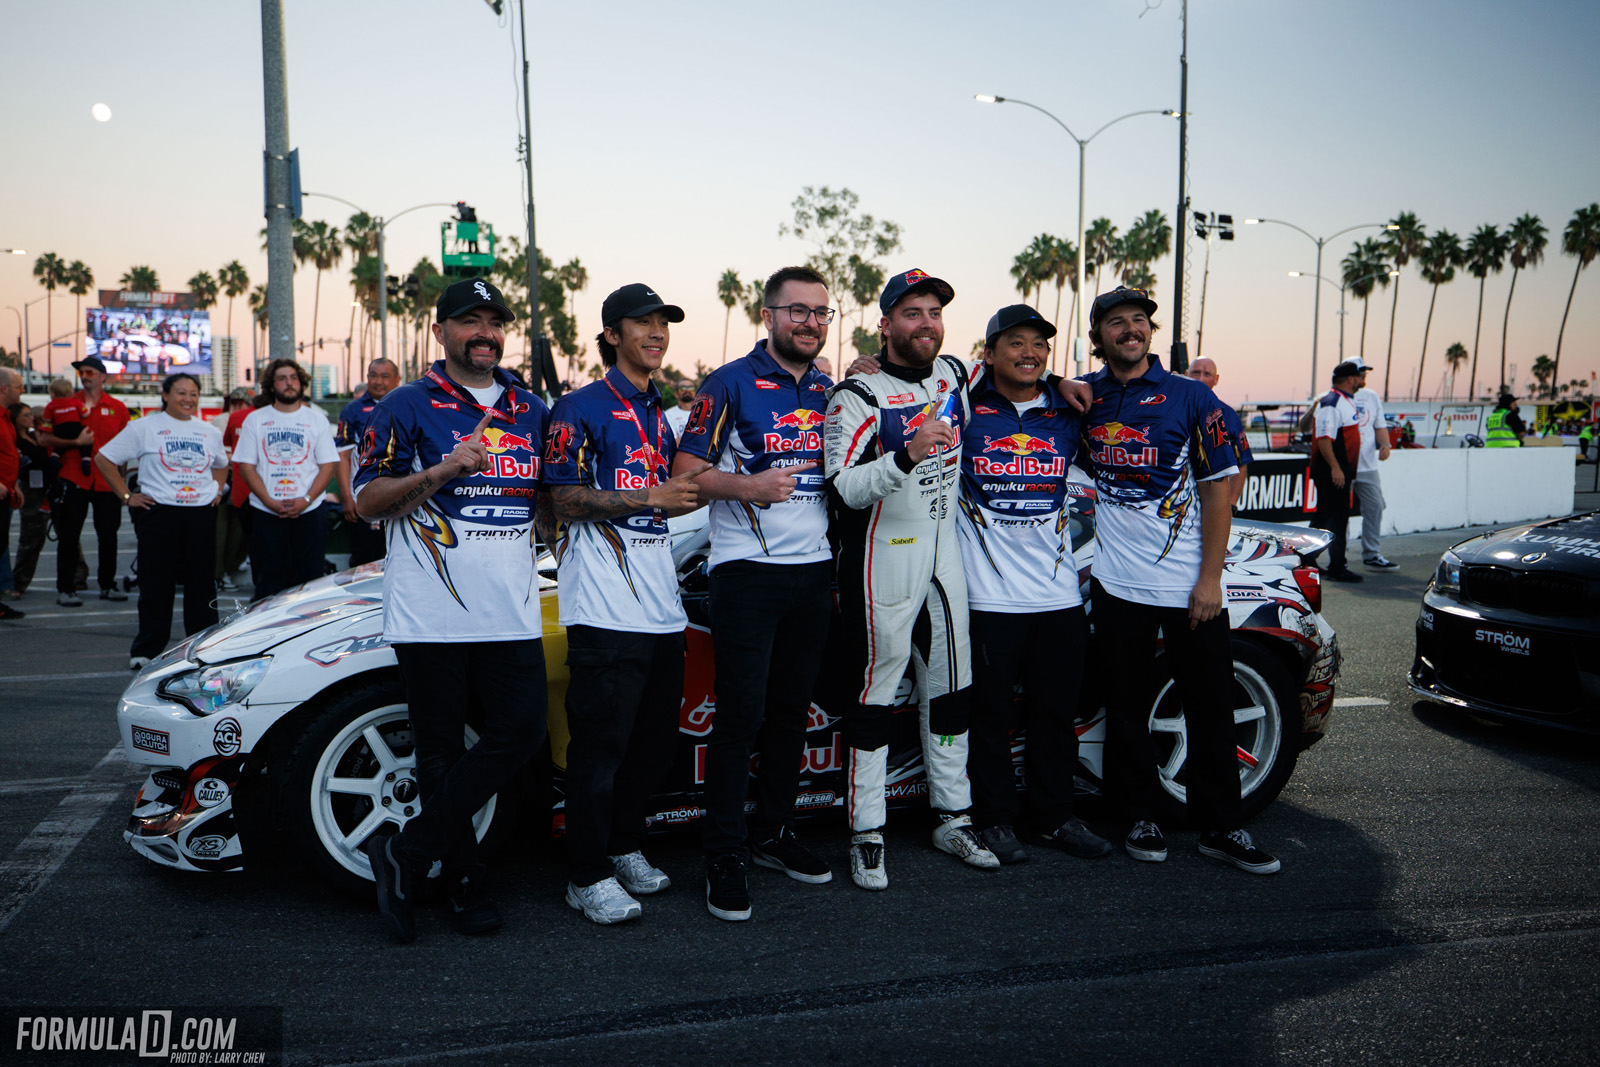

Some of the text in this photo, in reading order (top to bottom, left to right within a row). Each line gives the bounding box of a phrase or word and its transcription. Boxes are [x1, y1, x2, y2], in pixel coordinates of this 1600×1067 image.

[267, 431, 305, 448] CHAMPIONS
[763, 431, 824, 453] Red Bu
[165, 440, 205, 457] CHAMPIONS
[1090, 446, 1159, 467] ed Bull
[497, 455, 541, 480] Bull
[972, 456, 1022, 476] Red
[1022, 457, 1066, 477] Bull
[453, 484, 535, 498] enjukuracing
[982, 481, 1057, 494] enjukuracing
[1236, 472, 1304, 512] ORMULA
[891, 537, 915, 546] Sabelt
[1508, 534, 1600, 548] KUMH
[1475, 628, 1531, 650] STRÖM
[1500, 645, 1531, 656] WHEELS
[140, 731, 168, 744] OGURA
[214, 730, 240, 744] ACL
[140, 740, 169, 752] CLUTCH
[198, 789, 225, 801] CALLIES
[656, 807, 699, 821] STRÖM
